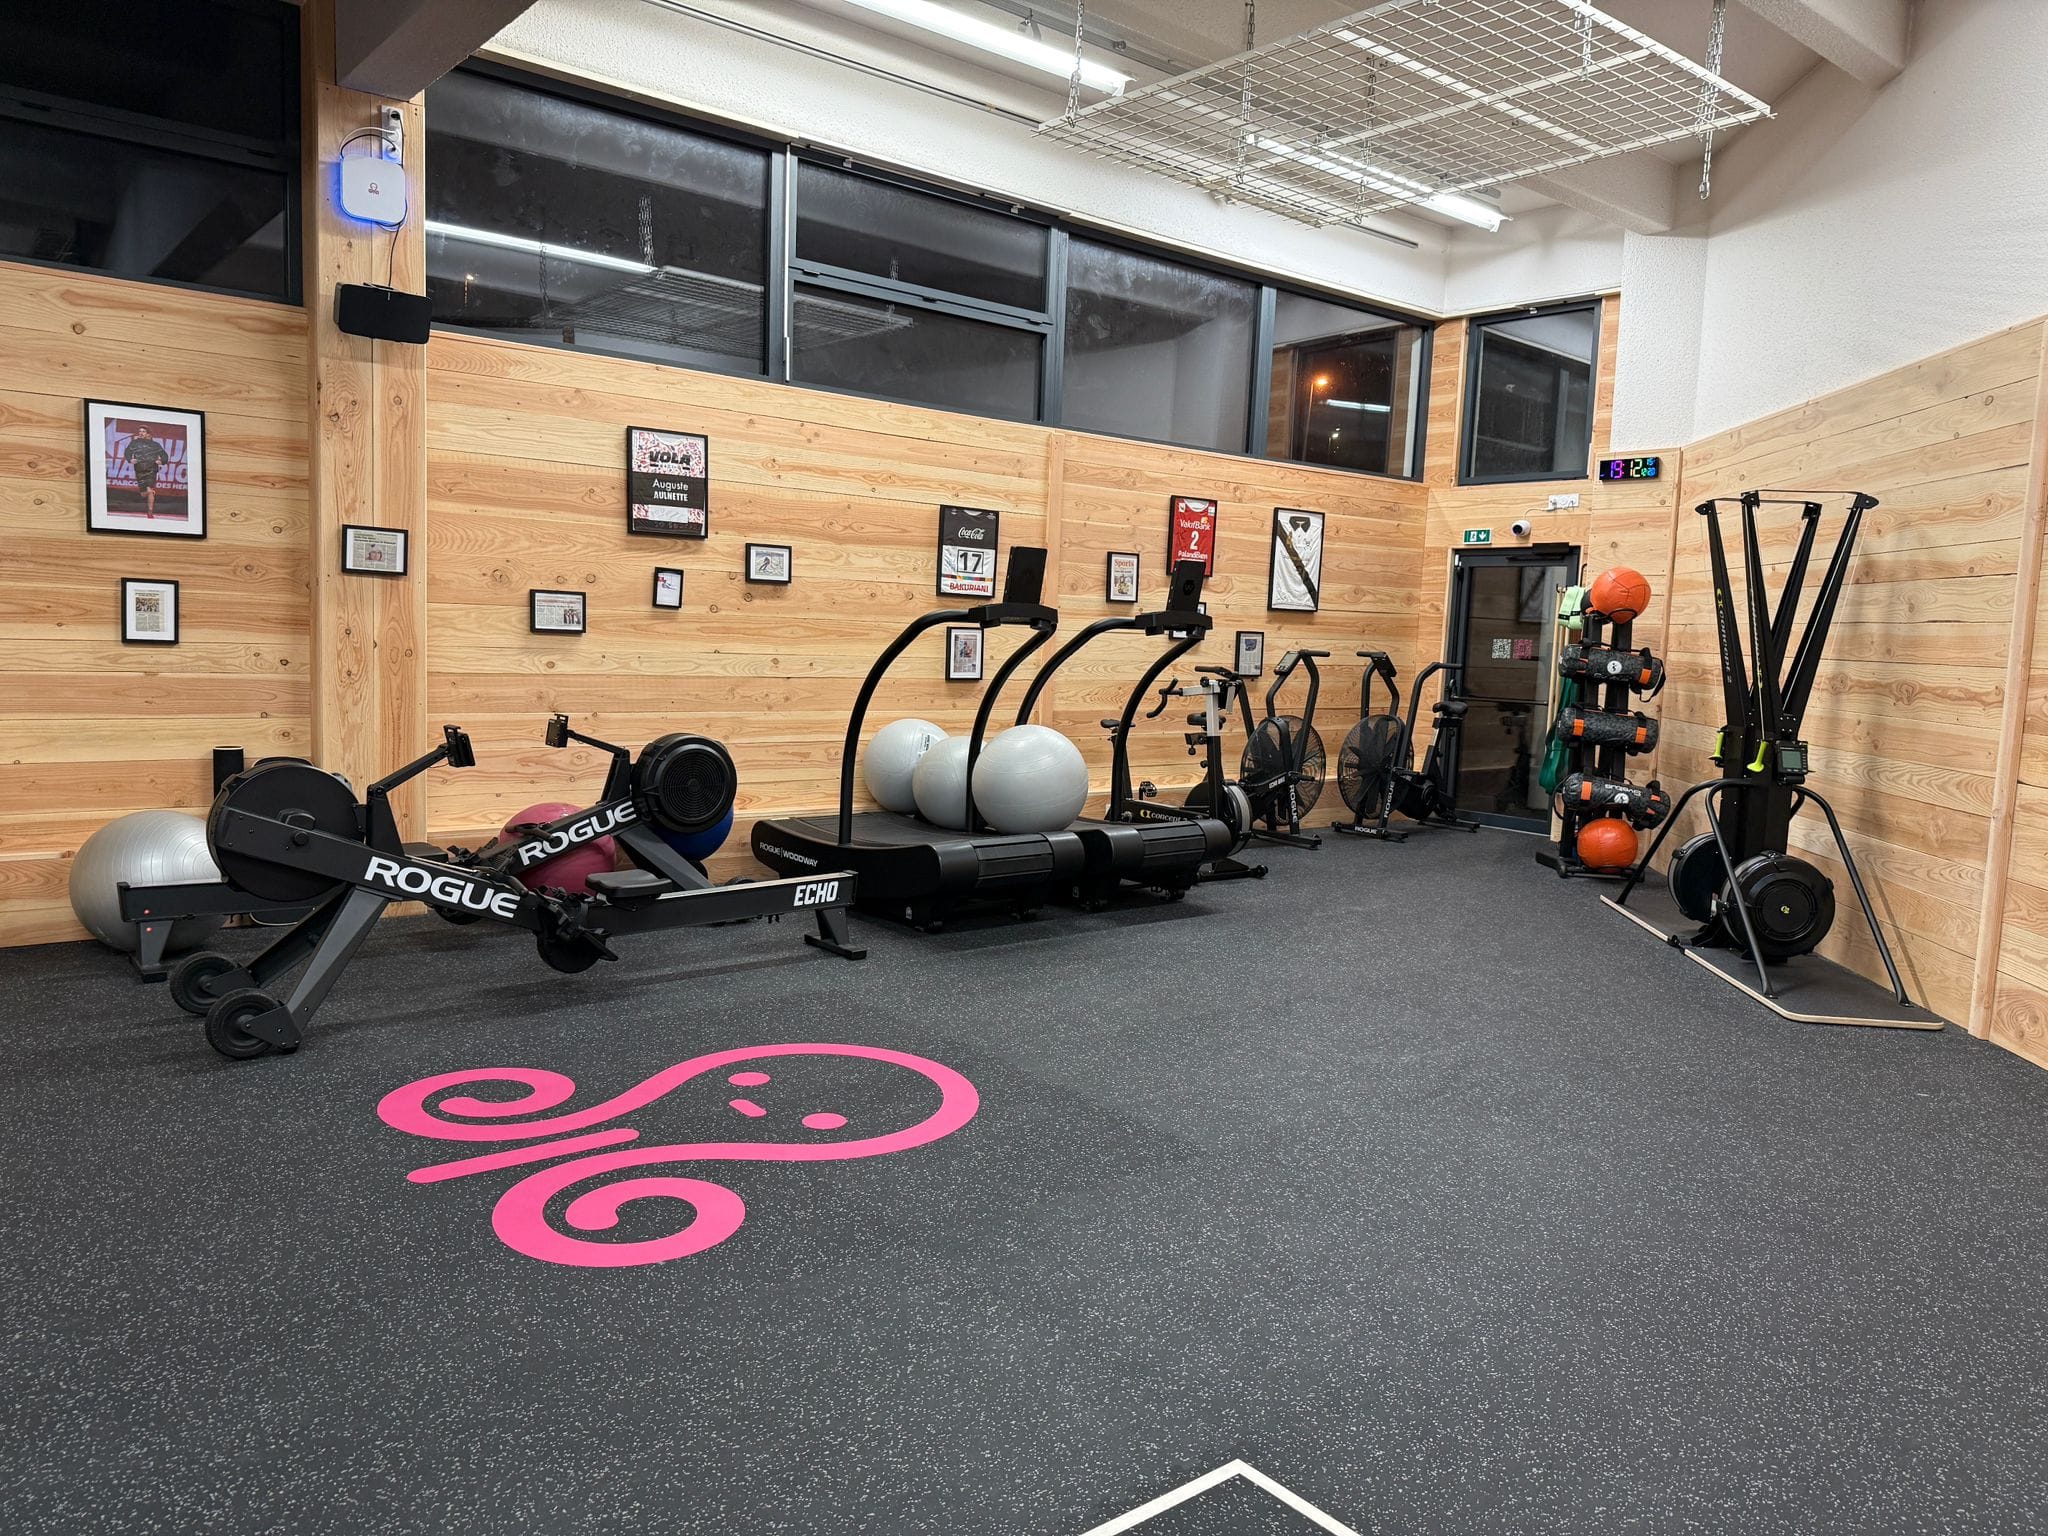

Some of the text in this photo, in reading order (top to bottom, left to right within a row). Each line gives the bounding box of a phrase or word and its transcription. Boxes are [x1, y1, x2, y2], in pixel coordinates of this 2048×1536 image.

[649, 450, 692, 465] VOLA
[652, 479, 689, 492] Auguste
[1189, 530, 1200, 551] 2
[959, 551, 982, 572] 17
[949, 582, 989, 593] BAKURIANI
[1289, 784, 1299, 823] ROGUE
[1384, 780, 1396, 818] ROGUE
[518, 800, 637, 866] ROGUE
[760, 842, 818, 867] ROGUE WOODWAY
[364, 855, 521, 919] ROGUE
[793, 881, 839, 907] ECHO
